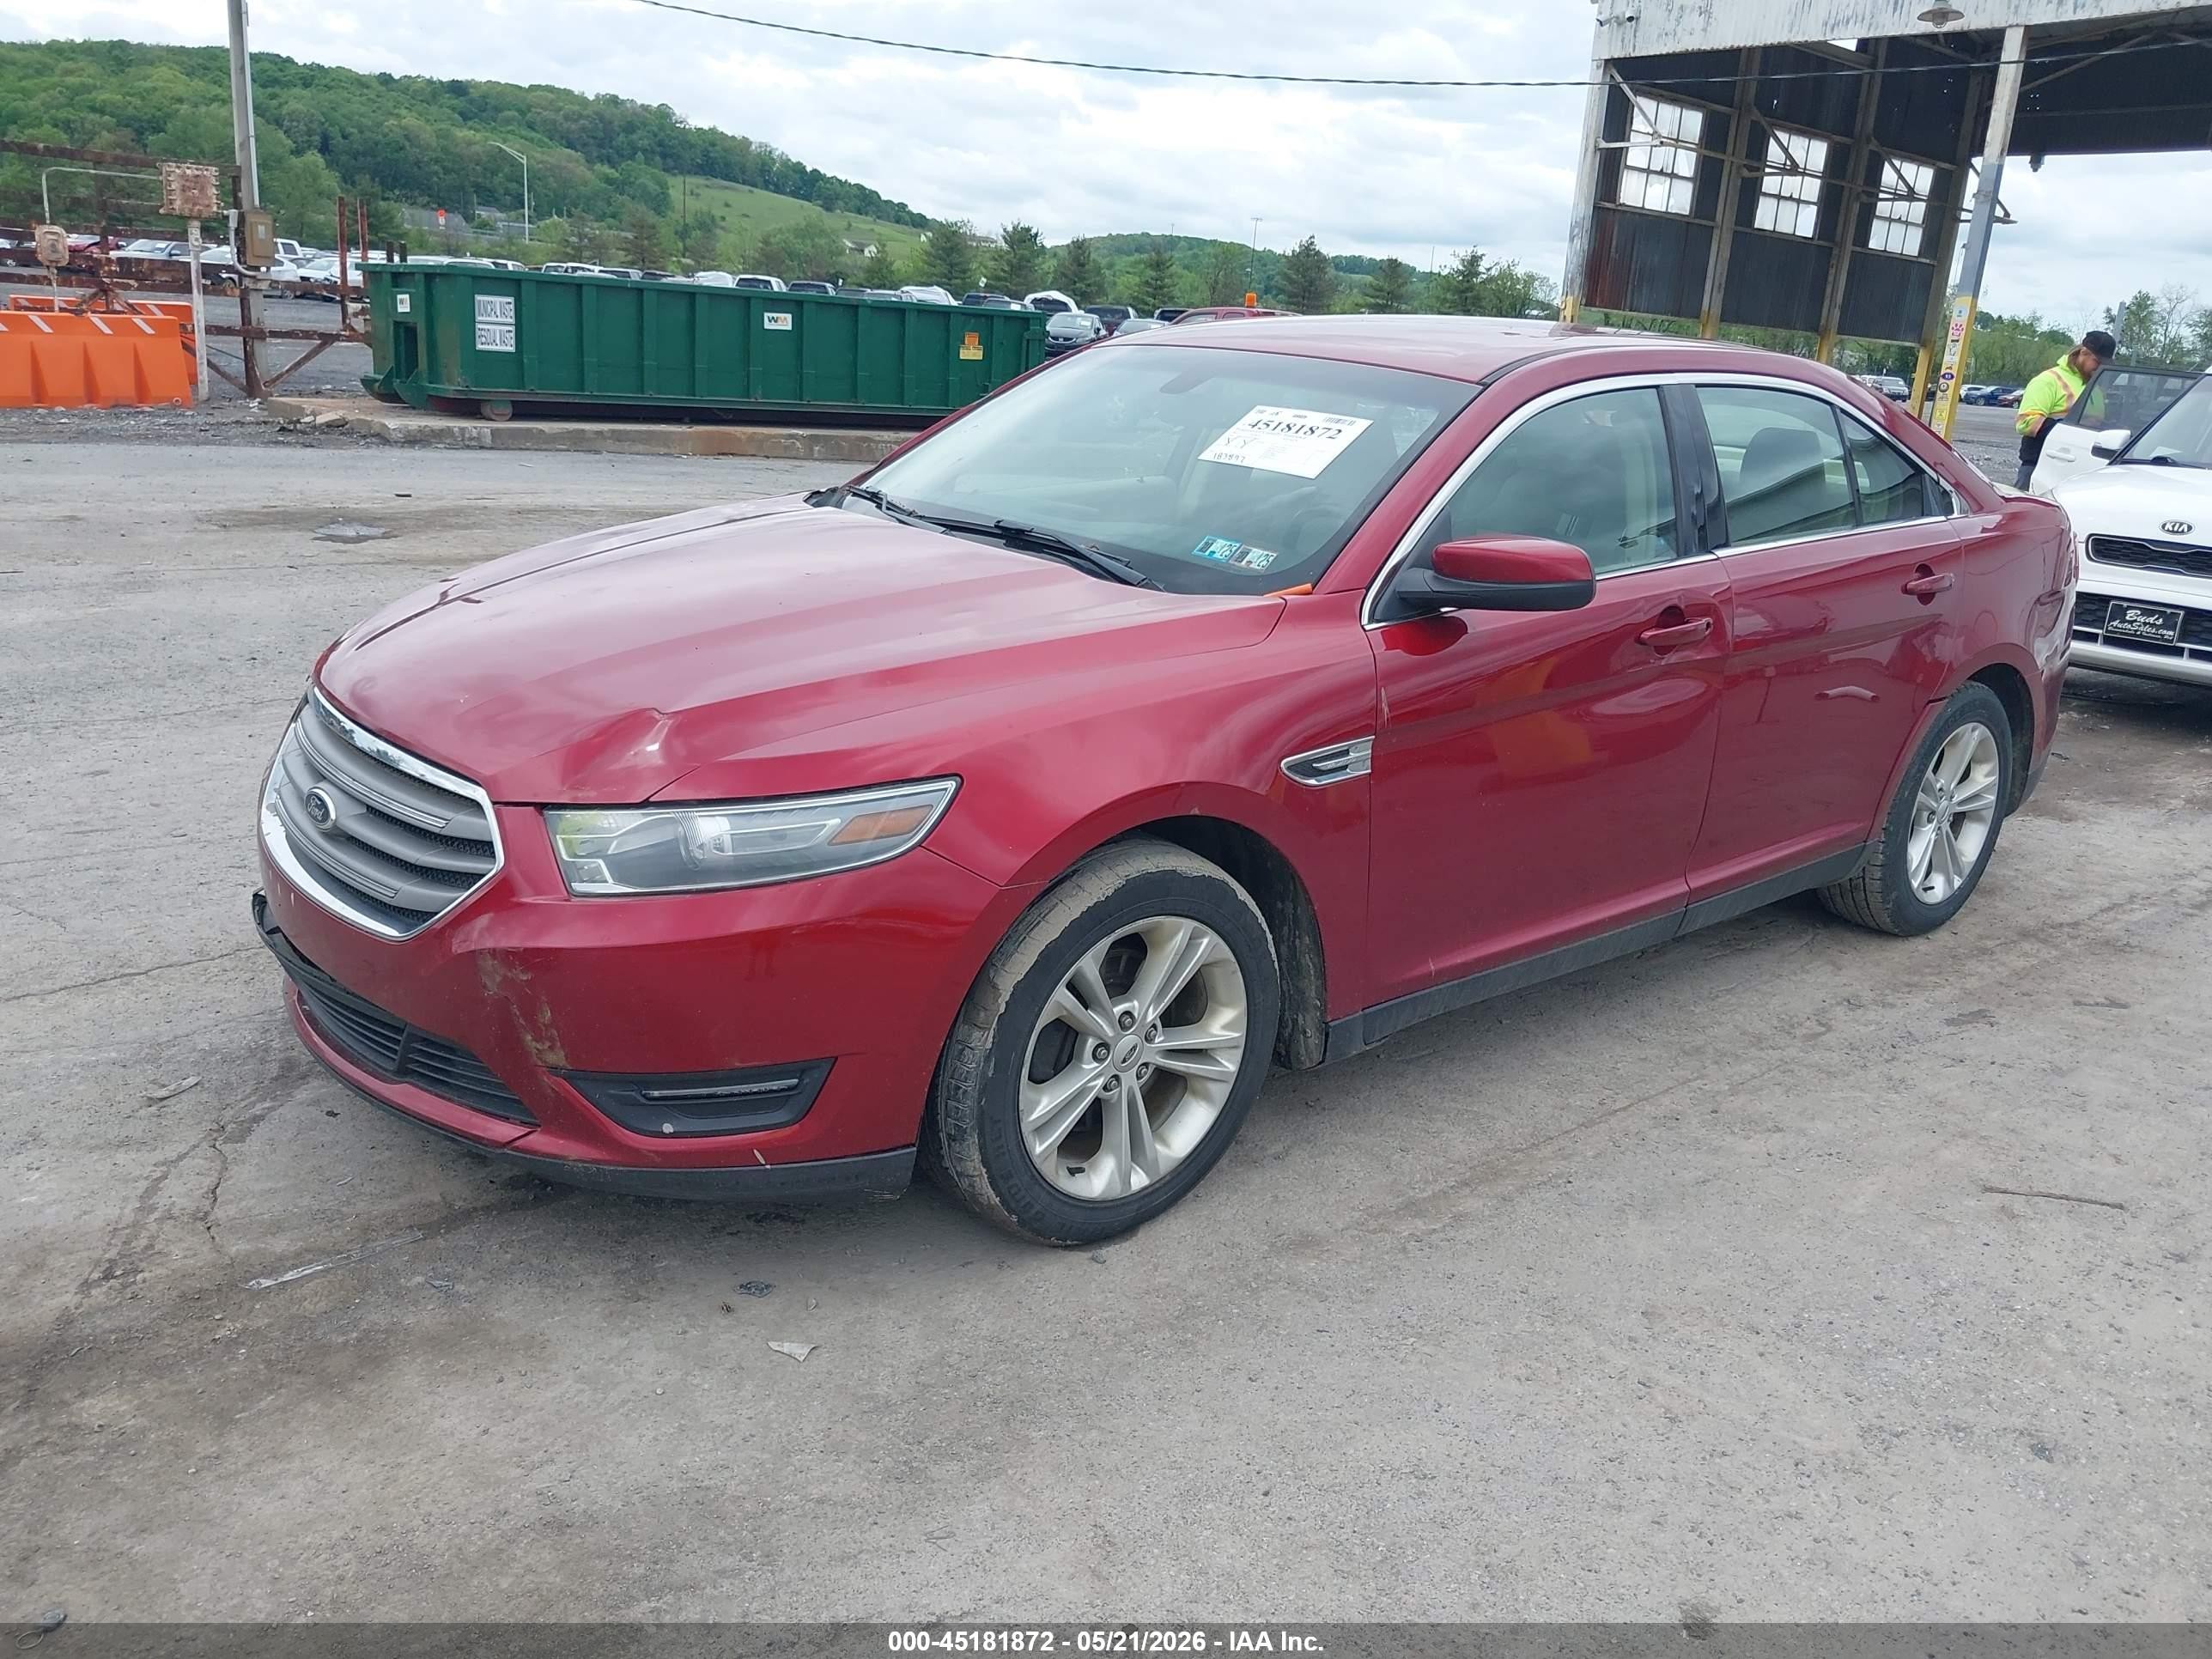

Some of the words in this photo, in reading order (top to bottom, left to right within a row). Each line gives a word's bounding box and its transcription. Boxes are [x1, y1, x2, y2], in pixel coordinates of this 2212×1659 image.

[500, 301, 514, 319] WASTE
[767, 315, 789, 325] WM
[500, 329, 514, 348] WASTE
[1248, 418, 1343, 440] 45181872
[2164, 522, 2189, 533] KIA
[2125, 610, 2163, 625] Buds
[2107, 620, 2175, 636] AutoSales.com
